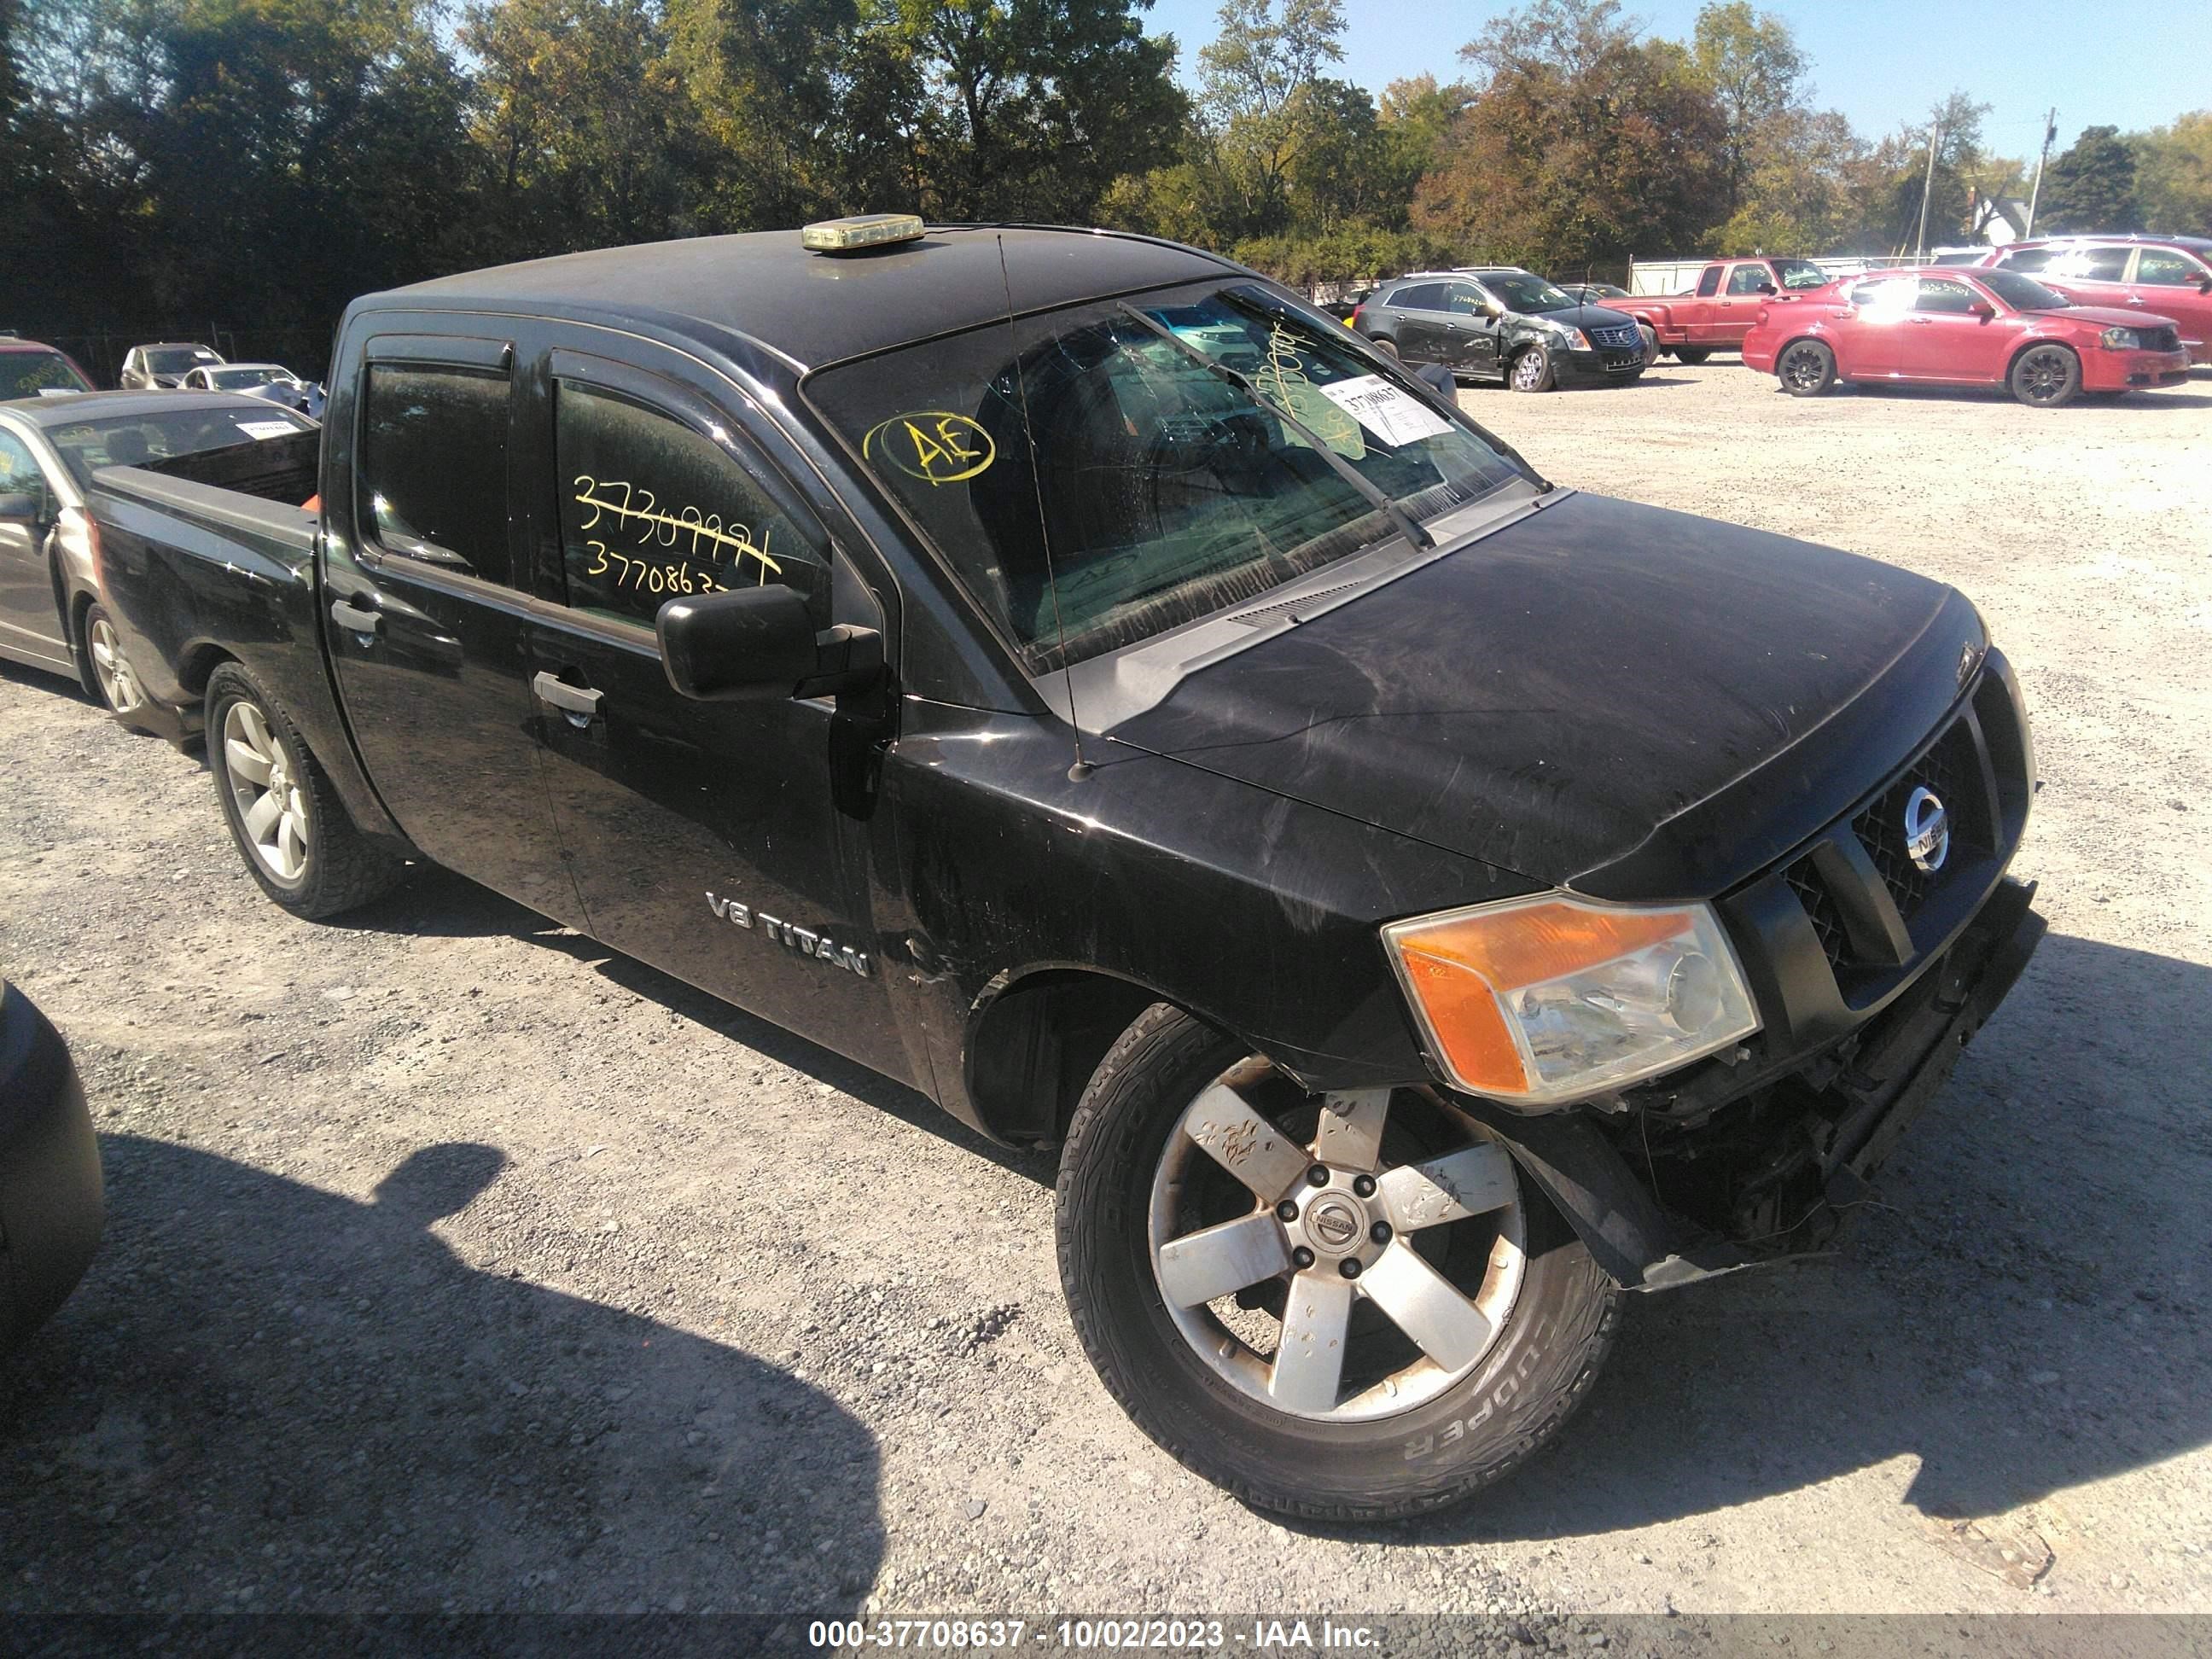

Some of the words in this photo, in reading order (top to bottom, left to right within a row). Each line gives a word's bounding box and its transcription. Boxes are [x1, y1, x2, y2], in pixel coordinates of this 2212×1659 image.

[706, 891, 752, 928] V8
[759, 911, 868, 977] TITAN
[1317, 1215, 1353, 1231] NISSAN
